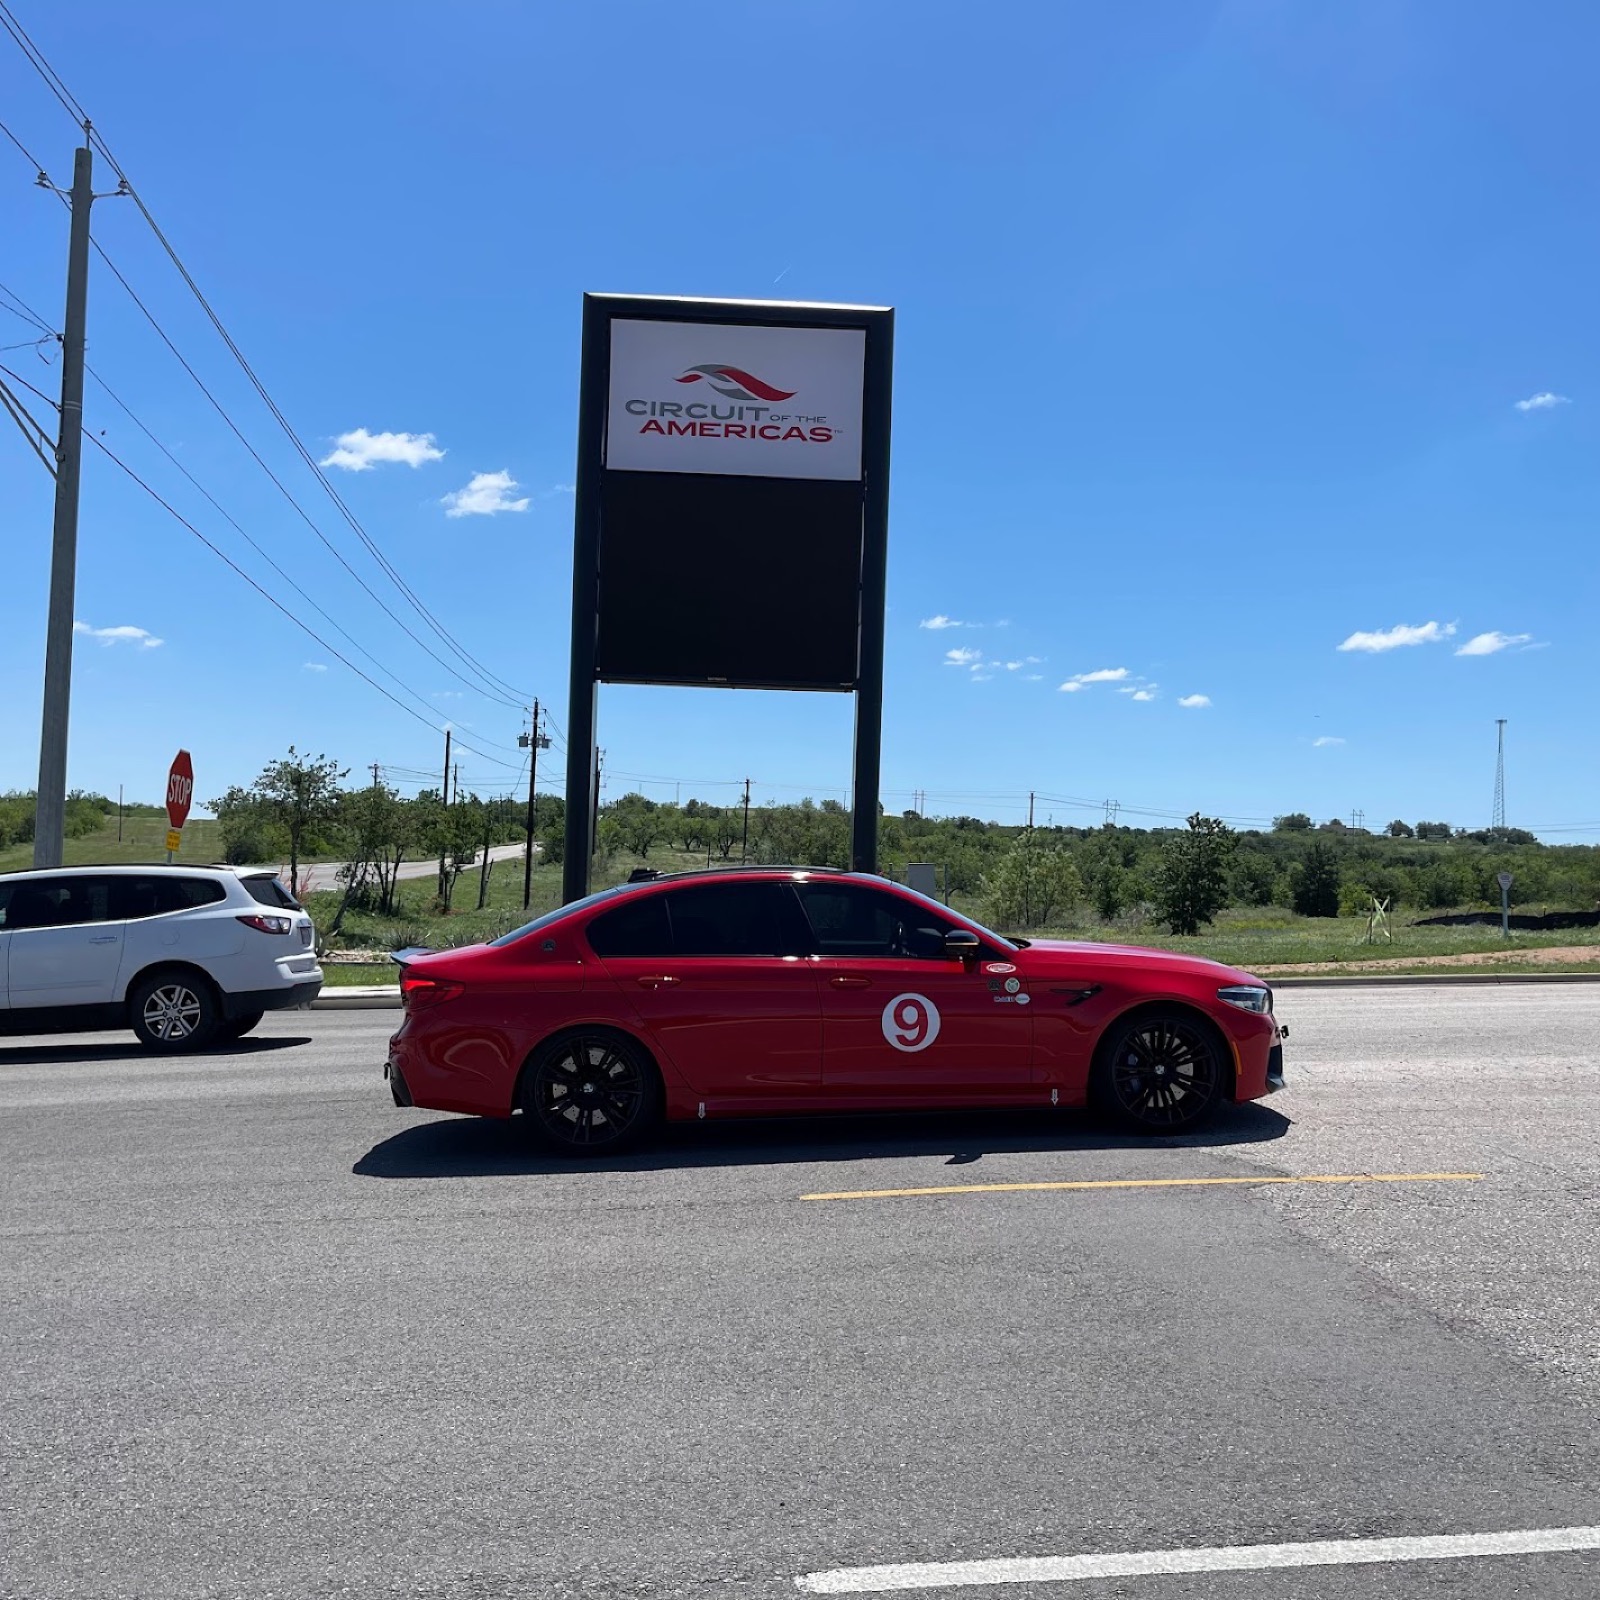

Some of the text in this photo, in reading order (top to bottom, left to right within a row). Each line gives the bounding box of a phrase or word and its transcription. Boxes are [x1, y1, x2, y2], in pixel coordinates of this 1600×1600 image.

[624, 399, 827, 424] CIRCUIT OF THE
[639, 419, 833, 443] AMERICAS
[168, 773, 192, 806] STOP
[893, 998, 929, 1047] 9
